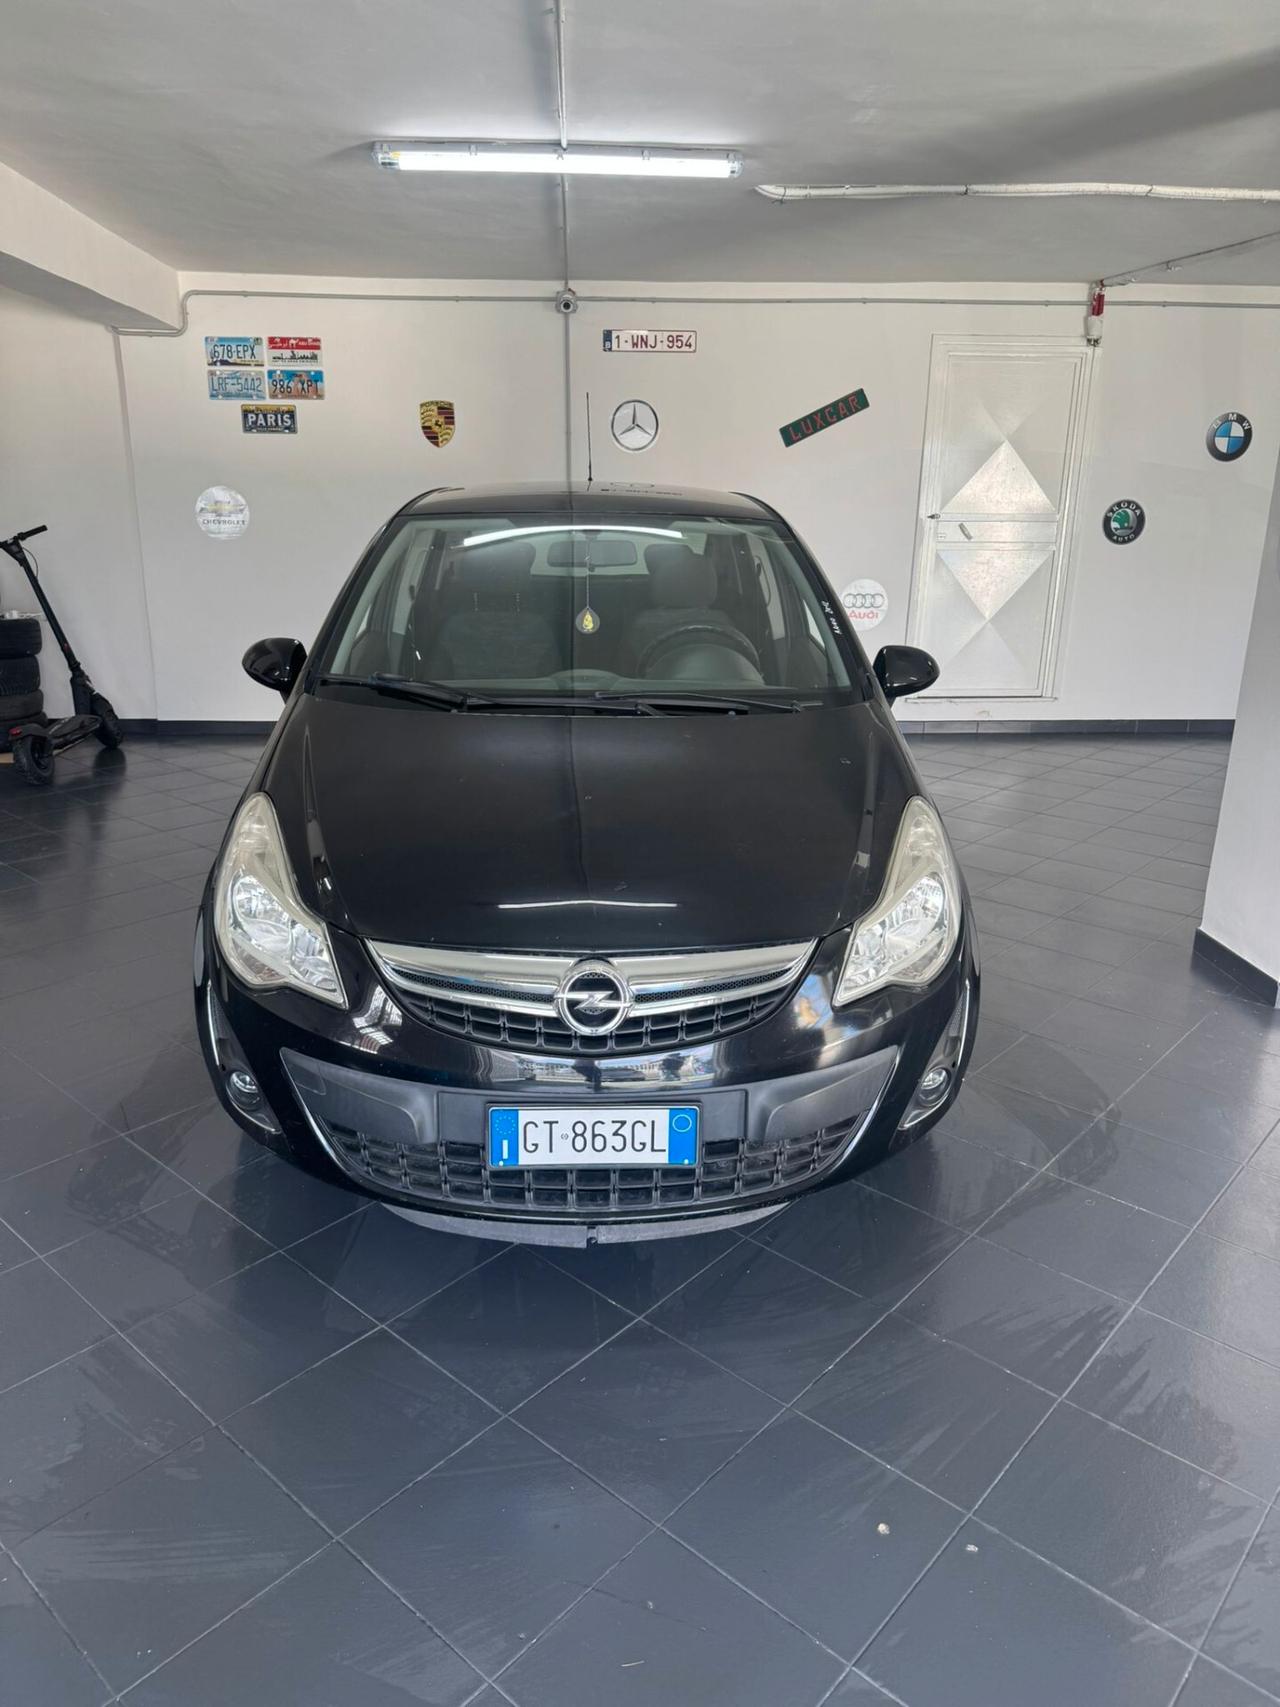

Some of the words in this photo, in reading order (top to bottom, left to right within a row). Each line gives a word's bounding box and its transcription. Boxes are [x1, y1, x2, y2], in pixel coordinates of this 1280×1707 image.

[247, 412, 292, 427] PARIS
[788, 395, 862, 441] LUXCAR
[522, 1119, 559, 1154] GT
[571, 1119, 667, 1154] 863GL
